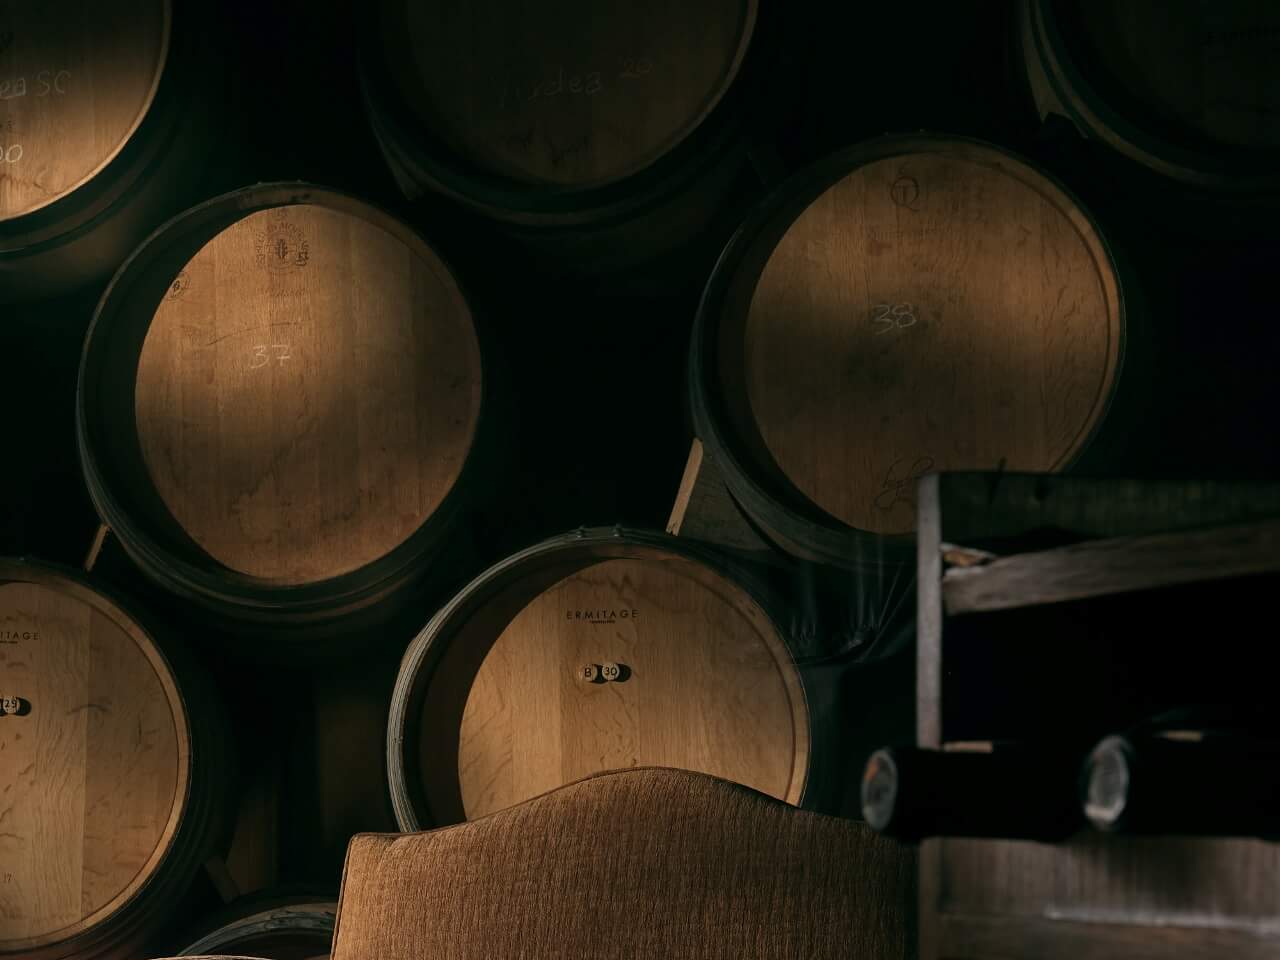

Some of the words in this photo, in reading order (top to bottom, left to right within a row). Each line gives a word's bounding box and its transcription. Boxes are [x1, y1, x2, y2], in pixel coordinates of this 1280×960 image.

[872, 302, 917, 335] 38
[250, 344, 291, 369] 37
[566, 608, 639, 620] ERMITAGE
